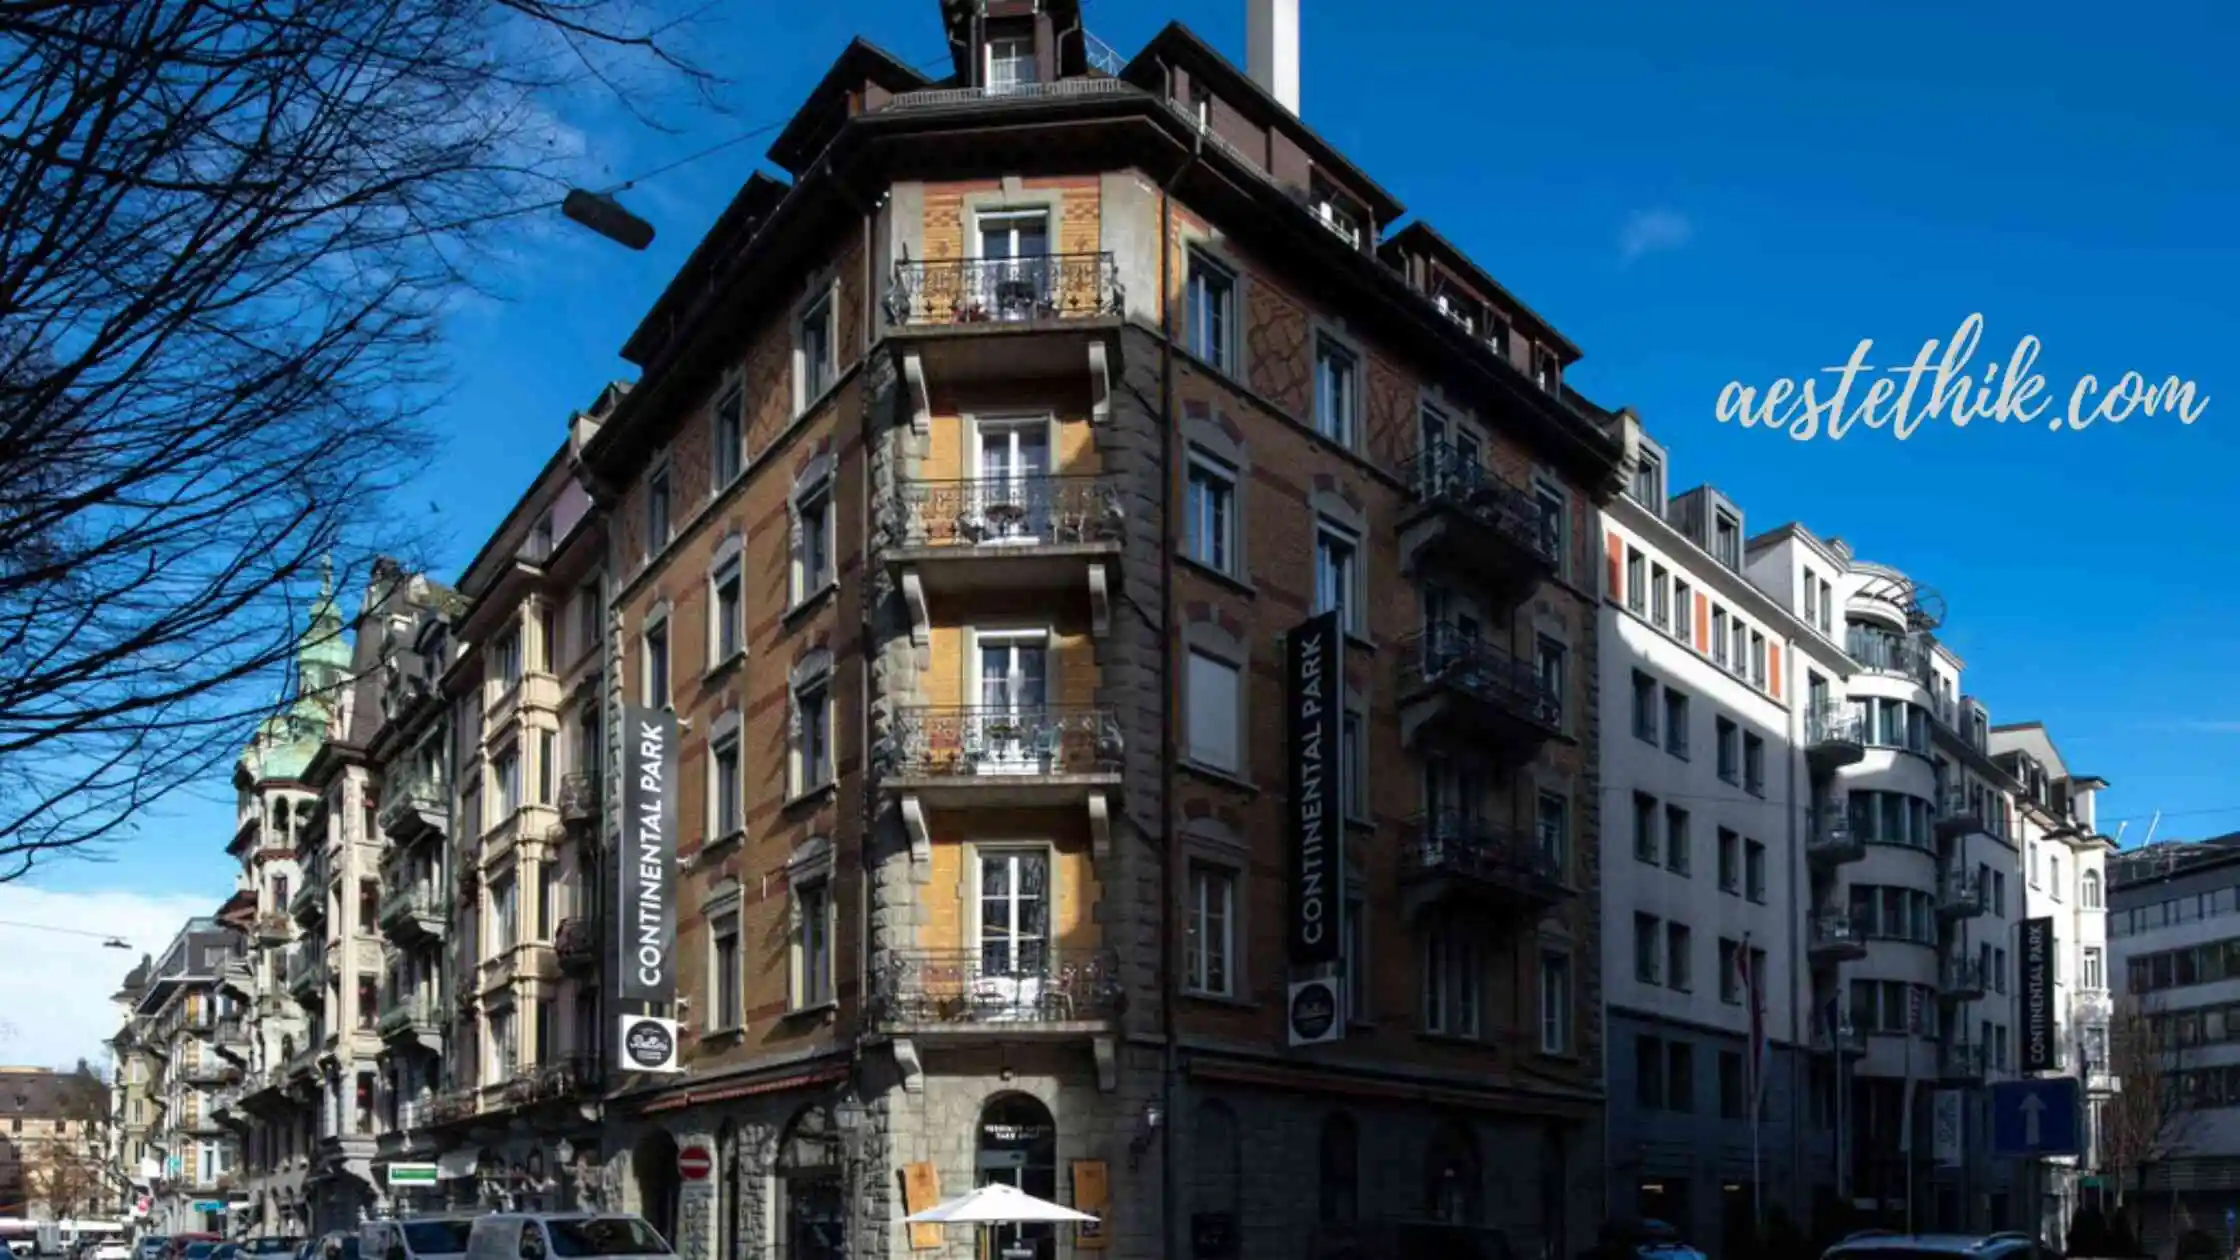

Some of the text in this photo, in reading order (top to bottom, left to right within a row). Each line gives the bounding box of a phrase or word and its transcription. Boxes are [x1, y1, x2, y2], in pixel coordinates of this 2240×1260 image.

[639, 721, 664, 987] CONTINENTAL PARK
[1302, 632, 1324, 945] CONTINENTAL PARK
[2028, 925, 2045, 1063] CONTINENTAL PARK
